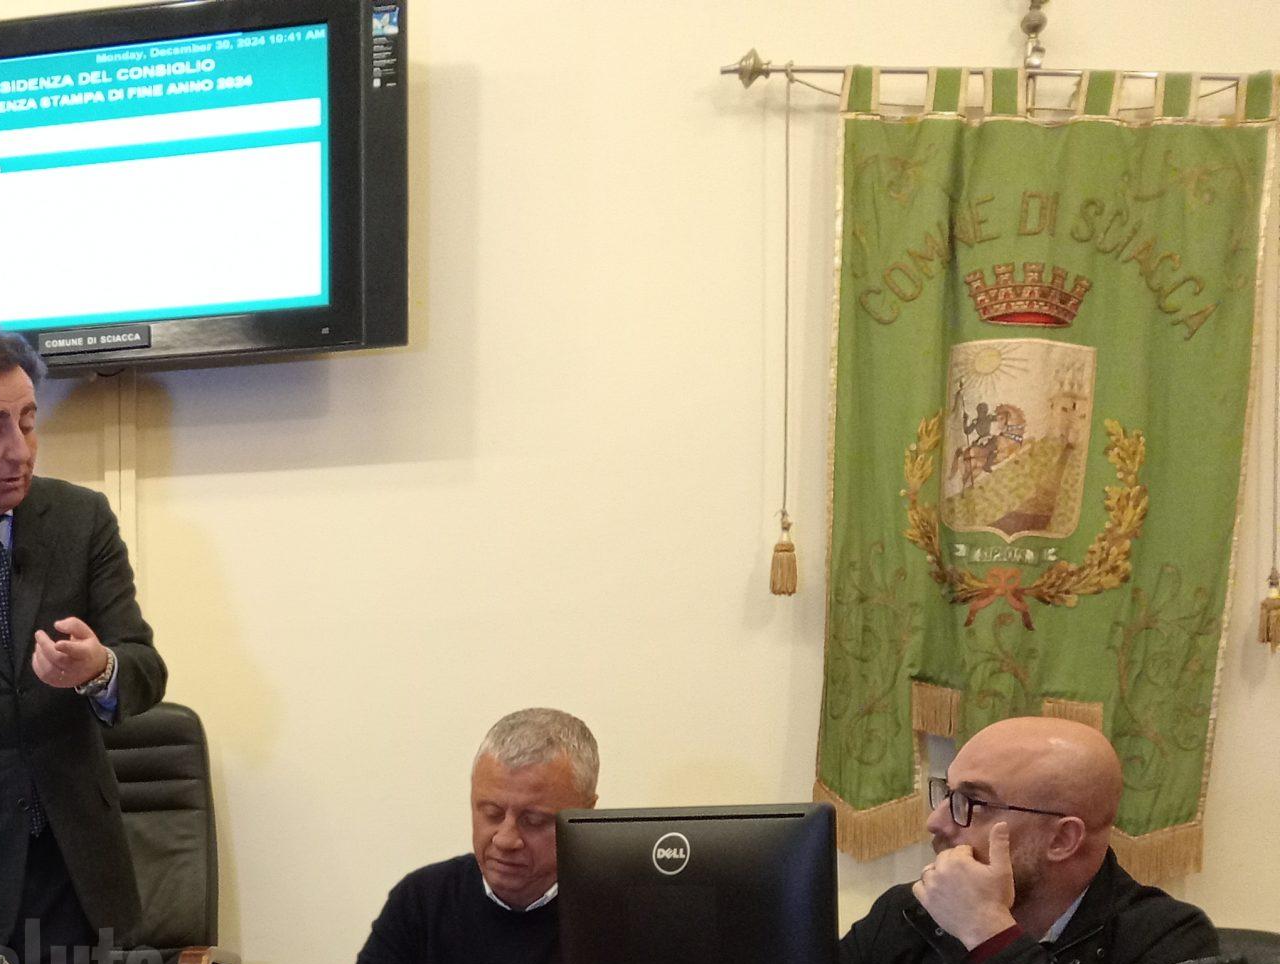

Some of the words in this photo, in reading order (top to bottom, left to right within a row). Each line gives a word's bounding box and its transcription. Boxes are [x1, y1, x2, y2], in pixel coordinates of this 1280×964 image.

[96, 48, 147, 63] Monday,
[150, 42, 212, 58] December
[269, 32, 301, 45] 10:41
[305, 28, 326, 41] AM
[78, 70, 112, 86] DEL
[116, 58, 216, 80] CONSIGLIO
[40, 90, 105, 109] STAMPA
[107, 88, 124, 102] DI
[127, 84, 164, 99] FINE
[167, 79, 214, 95] ANNO
[1020, 190, 1059, 238] DI
[1070, 198, 1220, 341] SCIACCA
[45, 337, 83, 348] COMUNE
[87, 335, 97, 345] DI
[100, 333, 141, 344] SCIACCA
[656, 848, 685, 859] DELL
